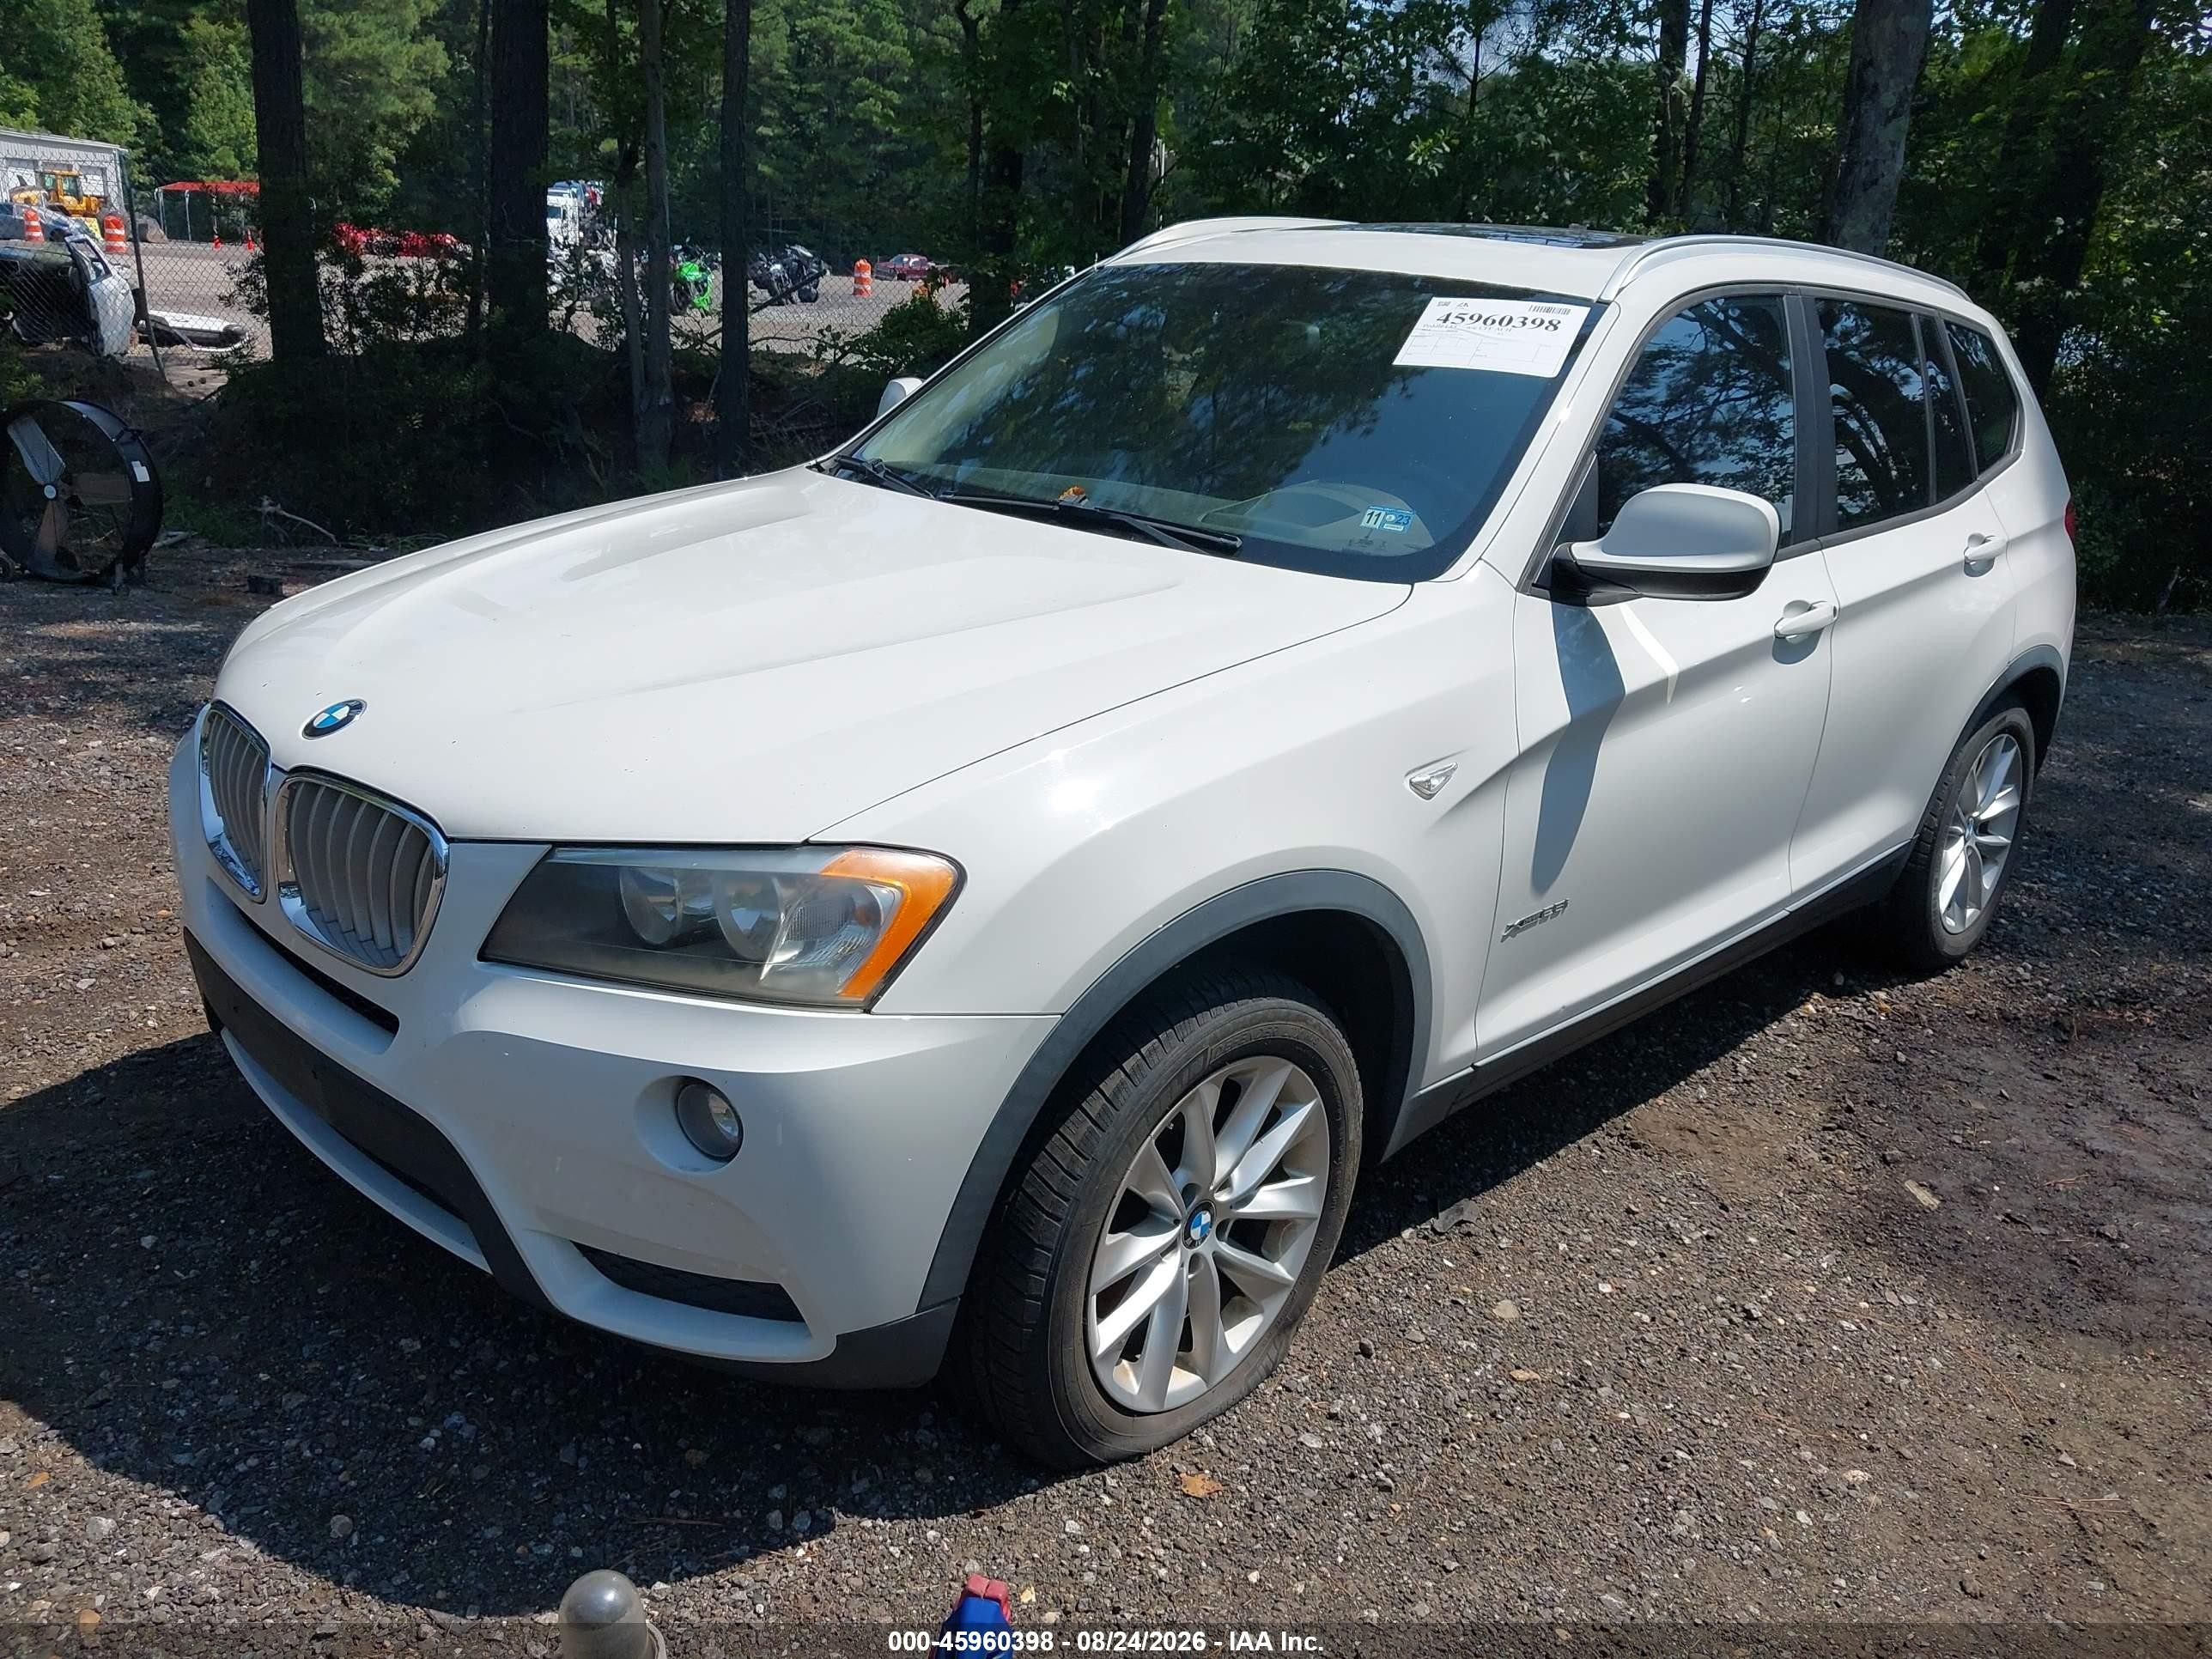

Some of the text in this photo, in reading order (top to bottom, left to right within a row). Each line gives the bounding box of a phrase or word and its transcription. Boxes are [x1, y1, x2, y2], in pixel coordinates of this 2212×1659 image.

[1436, 312, 1563, 333] 45960398
[1366, 511, 1411, 526] 11 23
